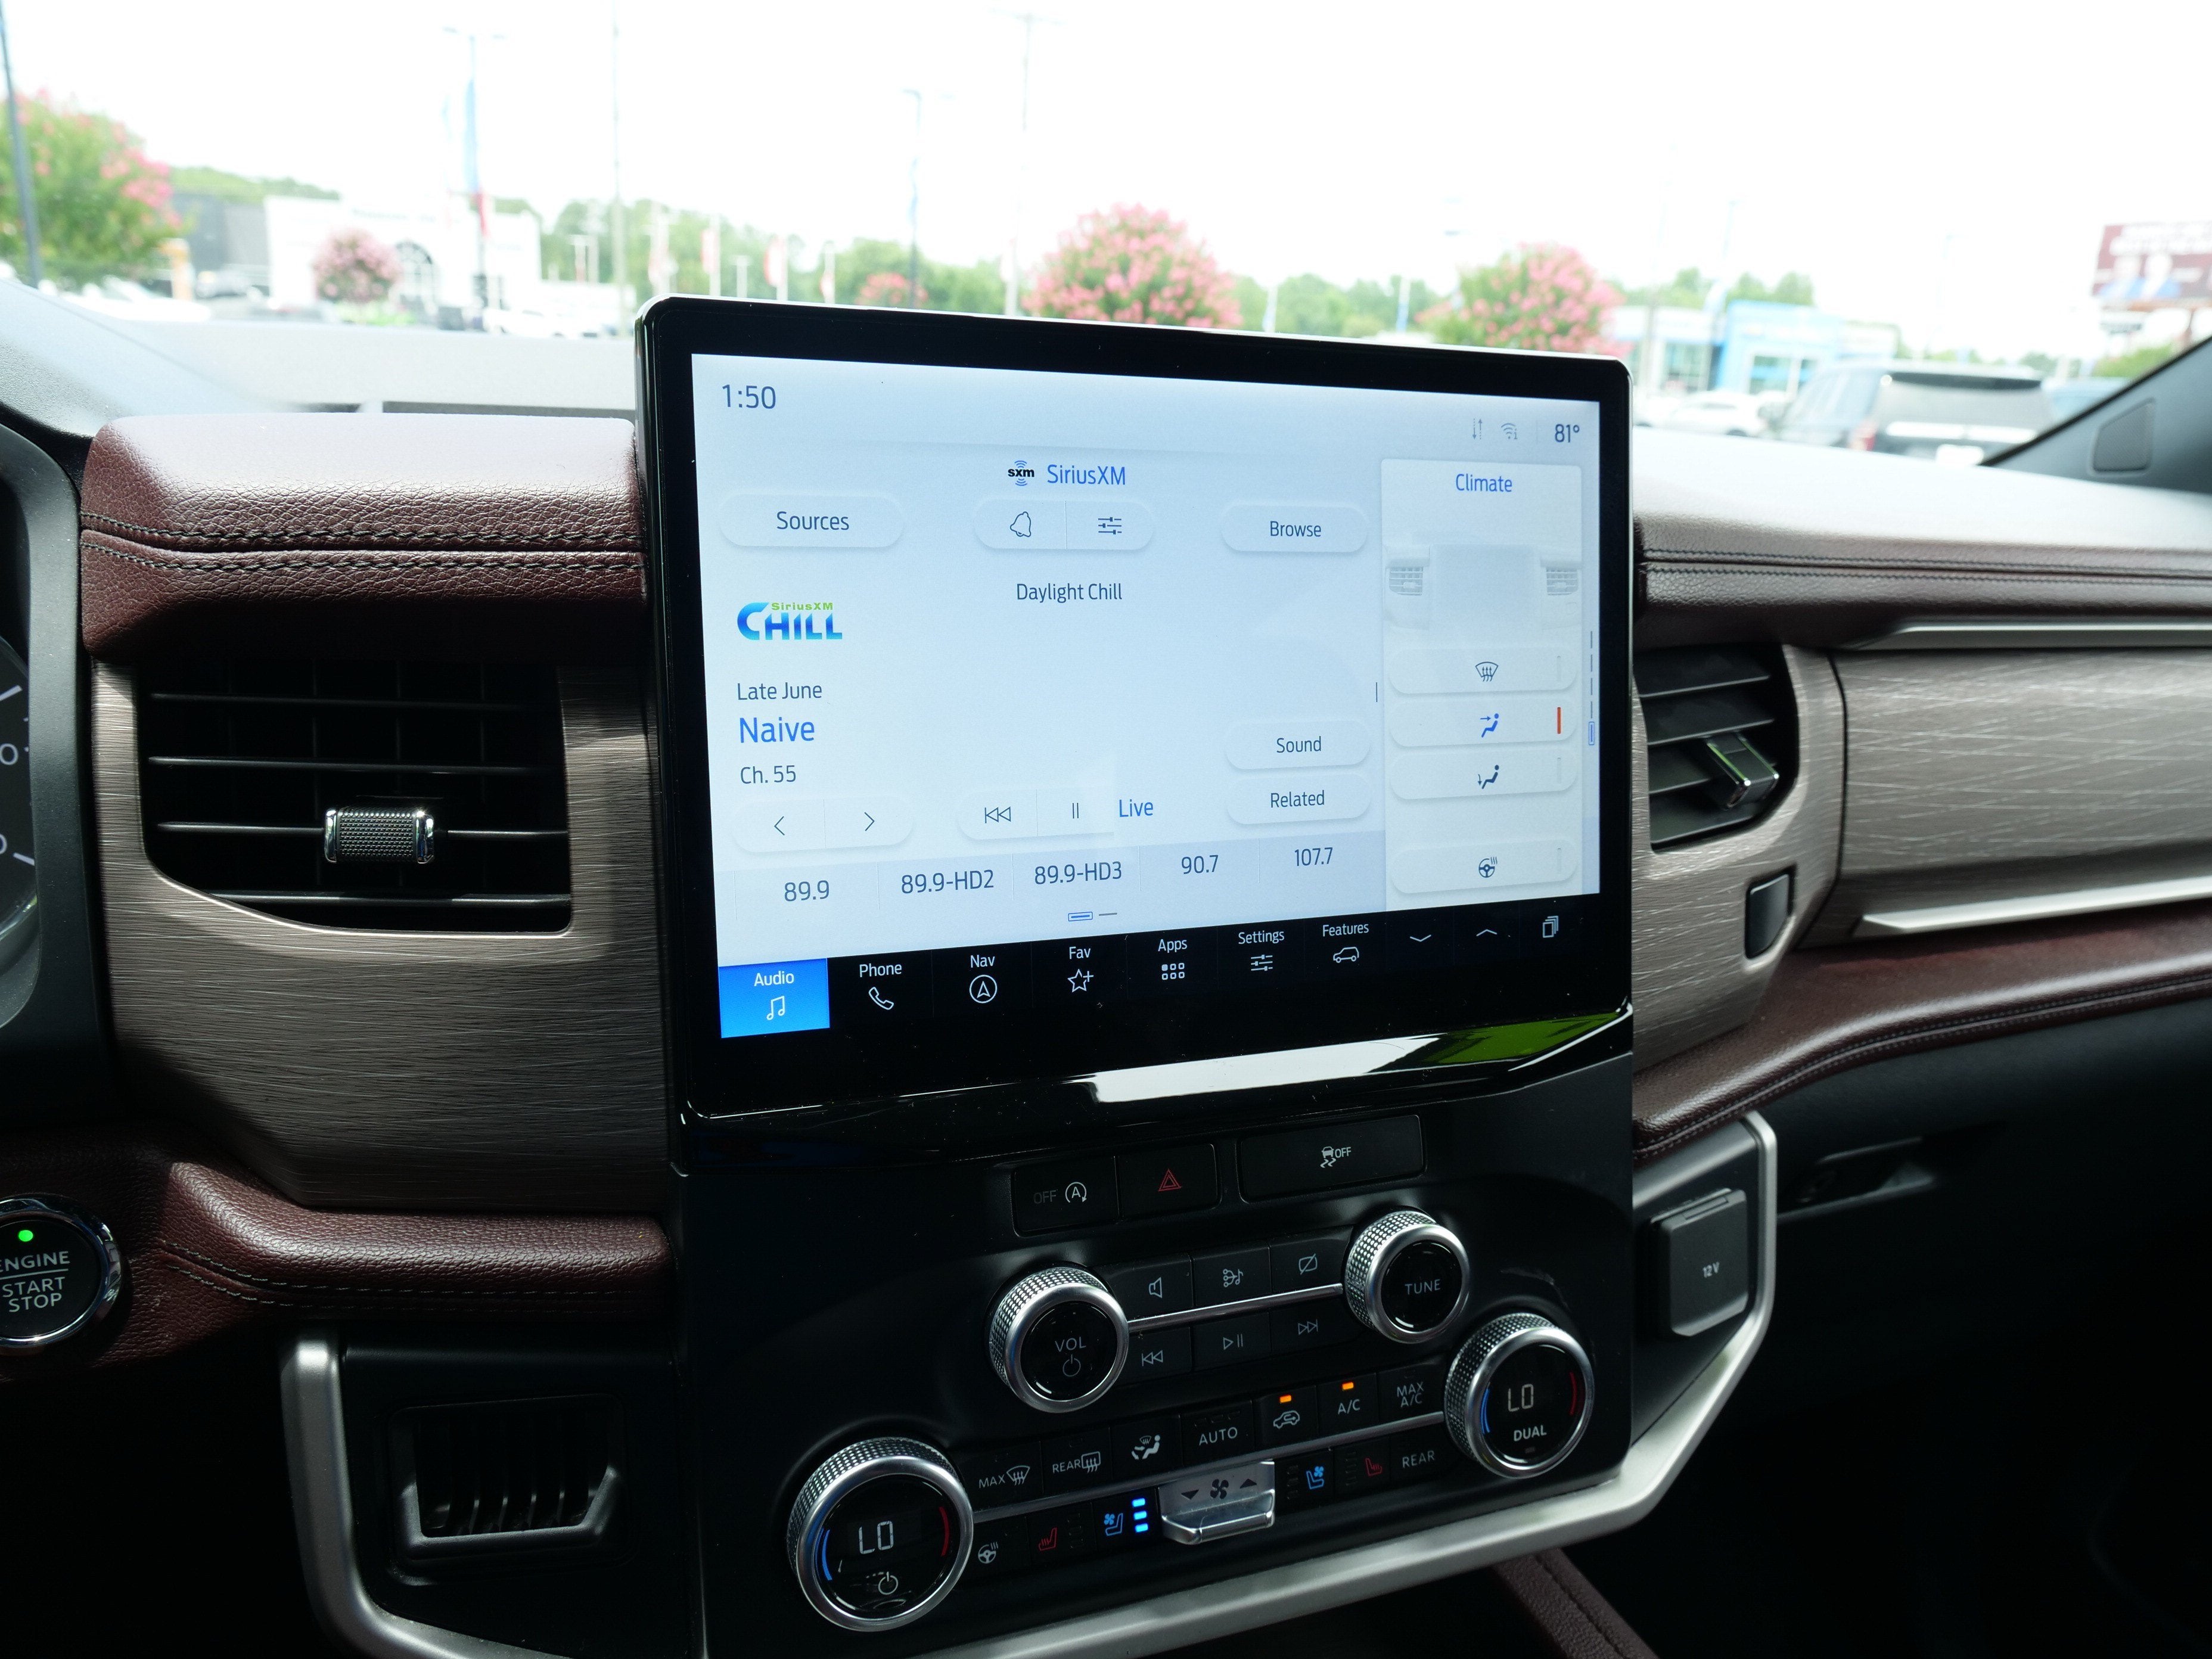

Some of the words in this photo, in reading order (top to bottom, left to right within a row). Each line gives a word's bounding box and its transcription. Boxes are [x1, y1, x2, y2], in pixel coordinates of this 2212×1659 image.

[722, 385, 775, 409] 1:50
[1555, 424, 1579, 442] 81°
[1048, 465, 1125, 484] SiriusXM
[1456, 474, 1512, 492] Climate
[777, 511, 849, 530] Sources
[1270, 521, 1321, 537] Browse
[1017, 583, 1083, 603] Daylight
[1089, 583, 1122, 599] Chill
[737, 602, 842, 640] CHILL
[738, 684, 776, 700] Late
[782, 682, 822, 699] June
[740, 717, 814, 743] Naive
[1277, 736, 1321, 753] Sound
[741, 766, 768, 784] Ch.
[774, 765, 796, 782] 55
[1271, 790, 1324, 807] Related
[1120, 799, 1153, 817] Live
[1182, 855, 1218, 874] 90.7
[1295, 847, 1332, 866] 107.7
[902, 869, 993, 893] 89.9-HD2
[1035, 862, 1121, 884] 89.9-HD3
[785, 880, 829, 902] 89.9
[1239, 930, 1284, 944] Settings
[1323, 924, 1369, 936] Features
[1070, 946, 1091, 959] Fav
[1158, 939, 1187, 953] Apps
[860, 964, 902, 977] Phone
[971, 955, 995, 968] Nav
[754, 971, 794, 986] Audio
[1335, 1147, 1351, 1158] OFF
[1034, 1190, 1056, 1203] OFF
[1703, 1262, 1719, 1277] 12V
[2, 1276, 65, 1297] START
[1405, 1279, 1440, 1294] TUNE
[8, 1293, 62, 1312] STOP
[1055, 1337, 1086, 1352] VOL
[1397, 1382, 1424, 1397] MAX
[1508, 1384, 1533, 1412] LO
[1338, 1399, 1360, 1414] A/C
[1400, 1392, 1422, 1408] A/C
[1200, 1427, 1237, 1445] AUTO
[1514, 1425, 1546, 1441] DUAL
[1053, 1459, 1080, 1472] REAR
[1403, 1450, 1434, 1468] REAR
[979, 1474, 1005, 1488] MAX
[859, 1521, 893, 1554] LO
